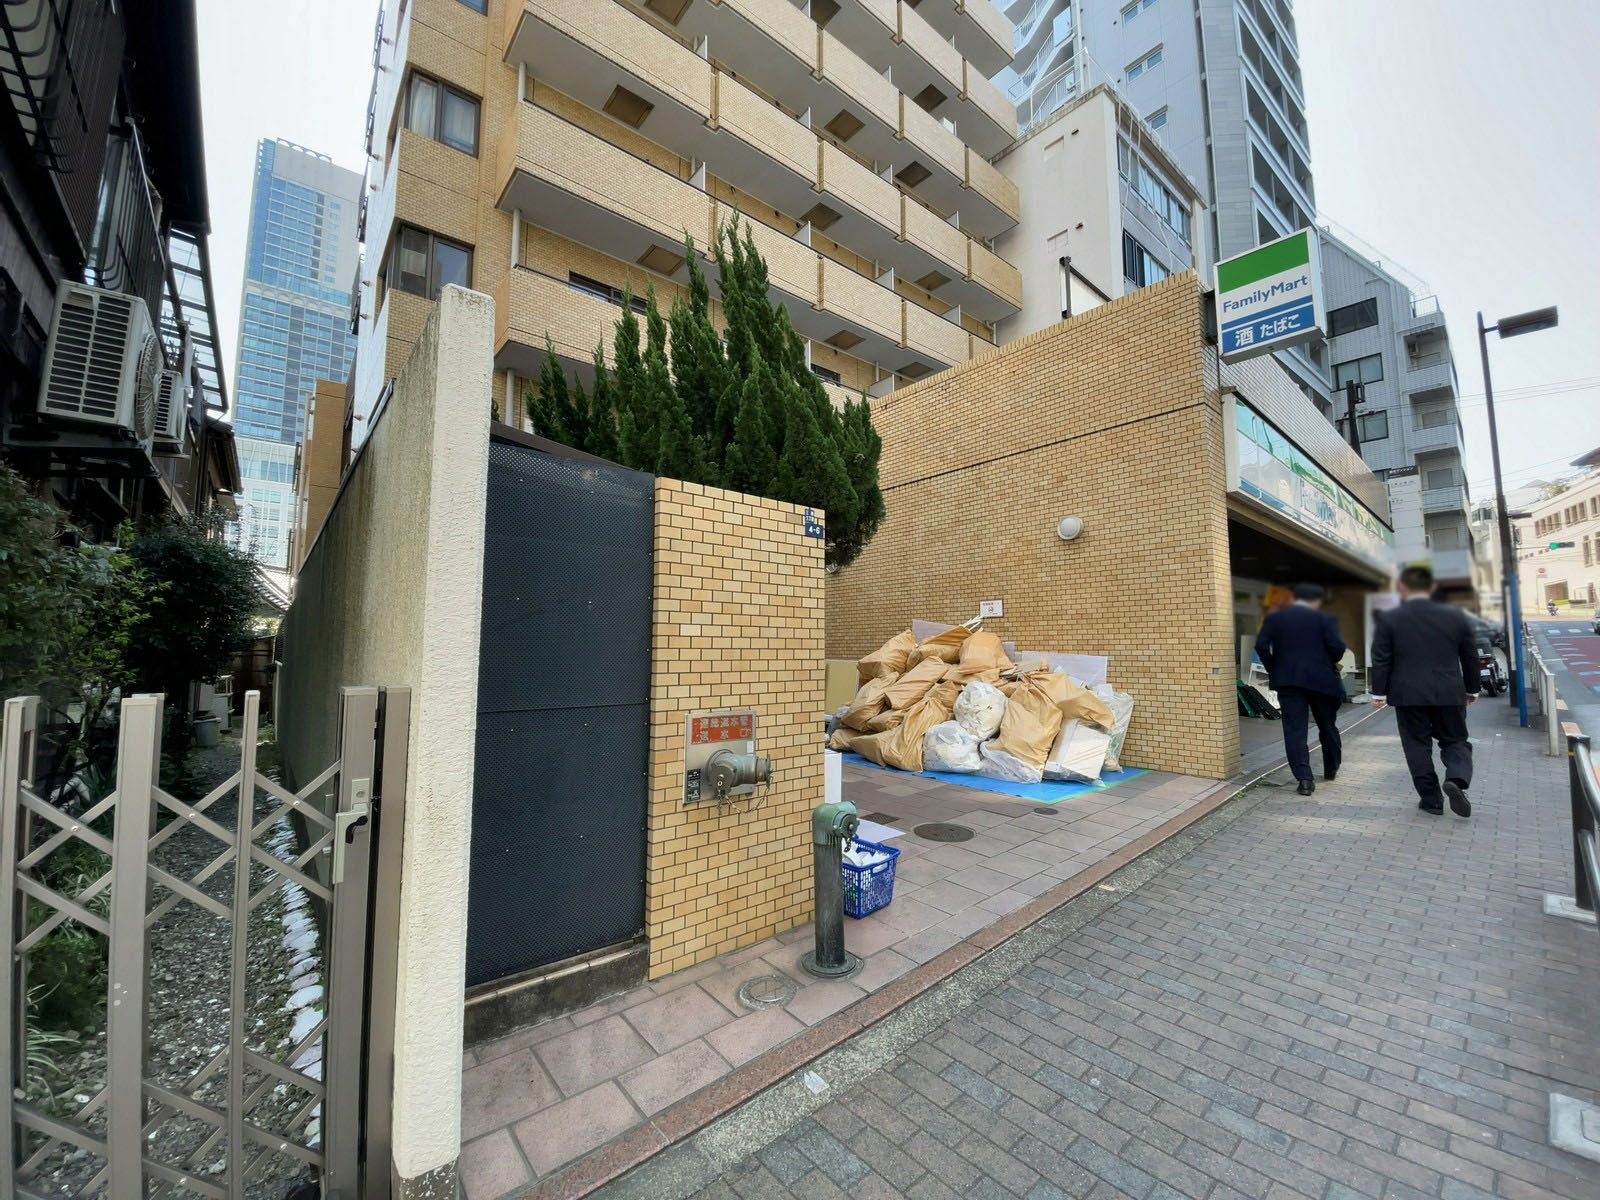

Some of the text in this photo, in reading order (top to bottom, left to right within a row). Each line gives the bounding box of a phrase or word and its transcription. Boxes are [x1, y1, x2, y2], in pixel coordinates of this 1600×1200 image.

[1223, 275, 1308, 313] FamilyMart
[1235, 313, 1301, 347] 酒 たばこ
